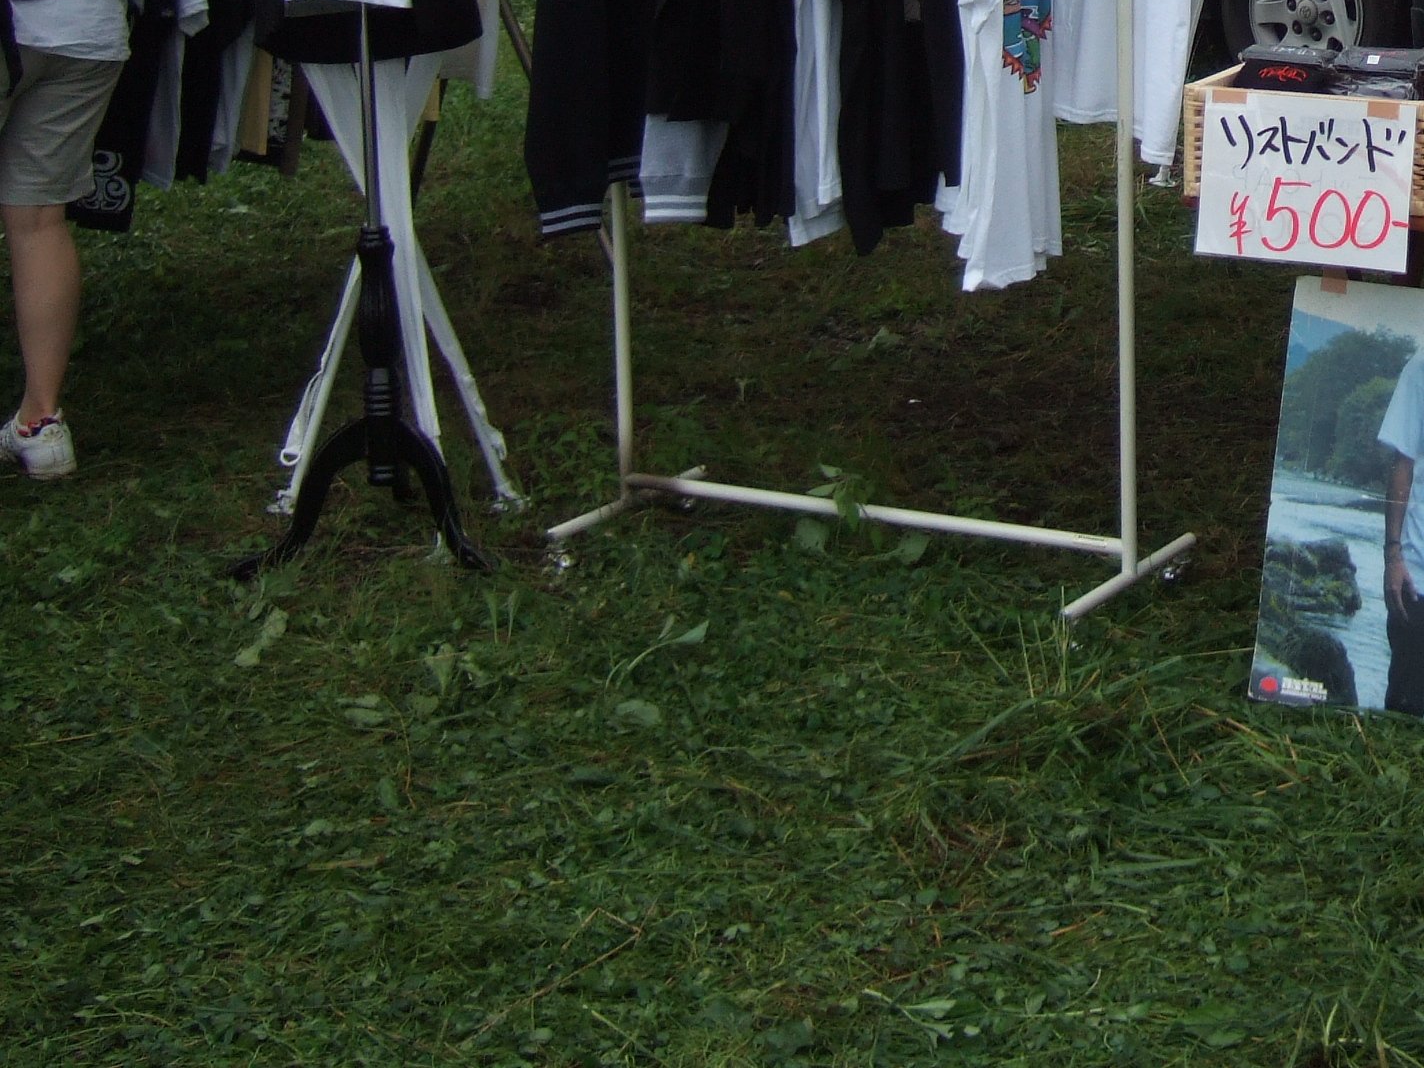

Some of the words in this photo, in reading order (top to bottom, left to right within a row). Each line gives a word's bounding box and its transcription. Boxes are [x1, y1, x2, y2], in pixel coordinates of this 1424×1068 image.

[1220, 114, 1407, 172] リストバンド
